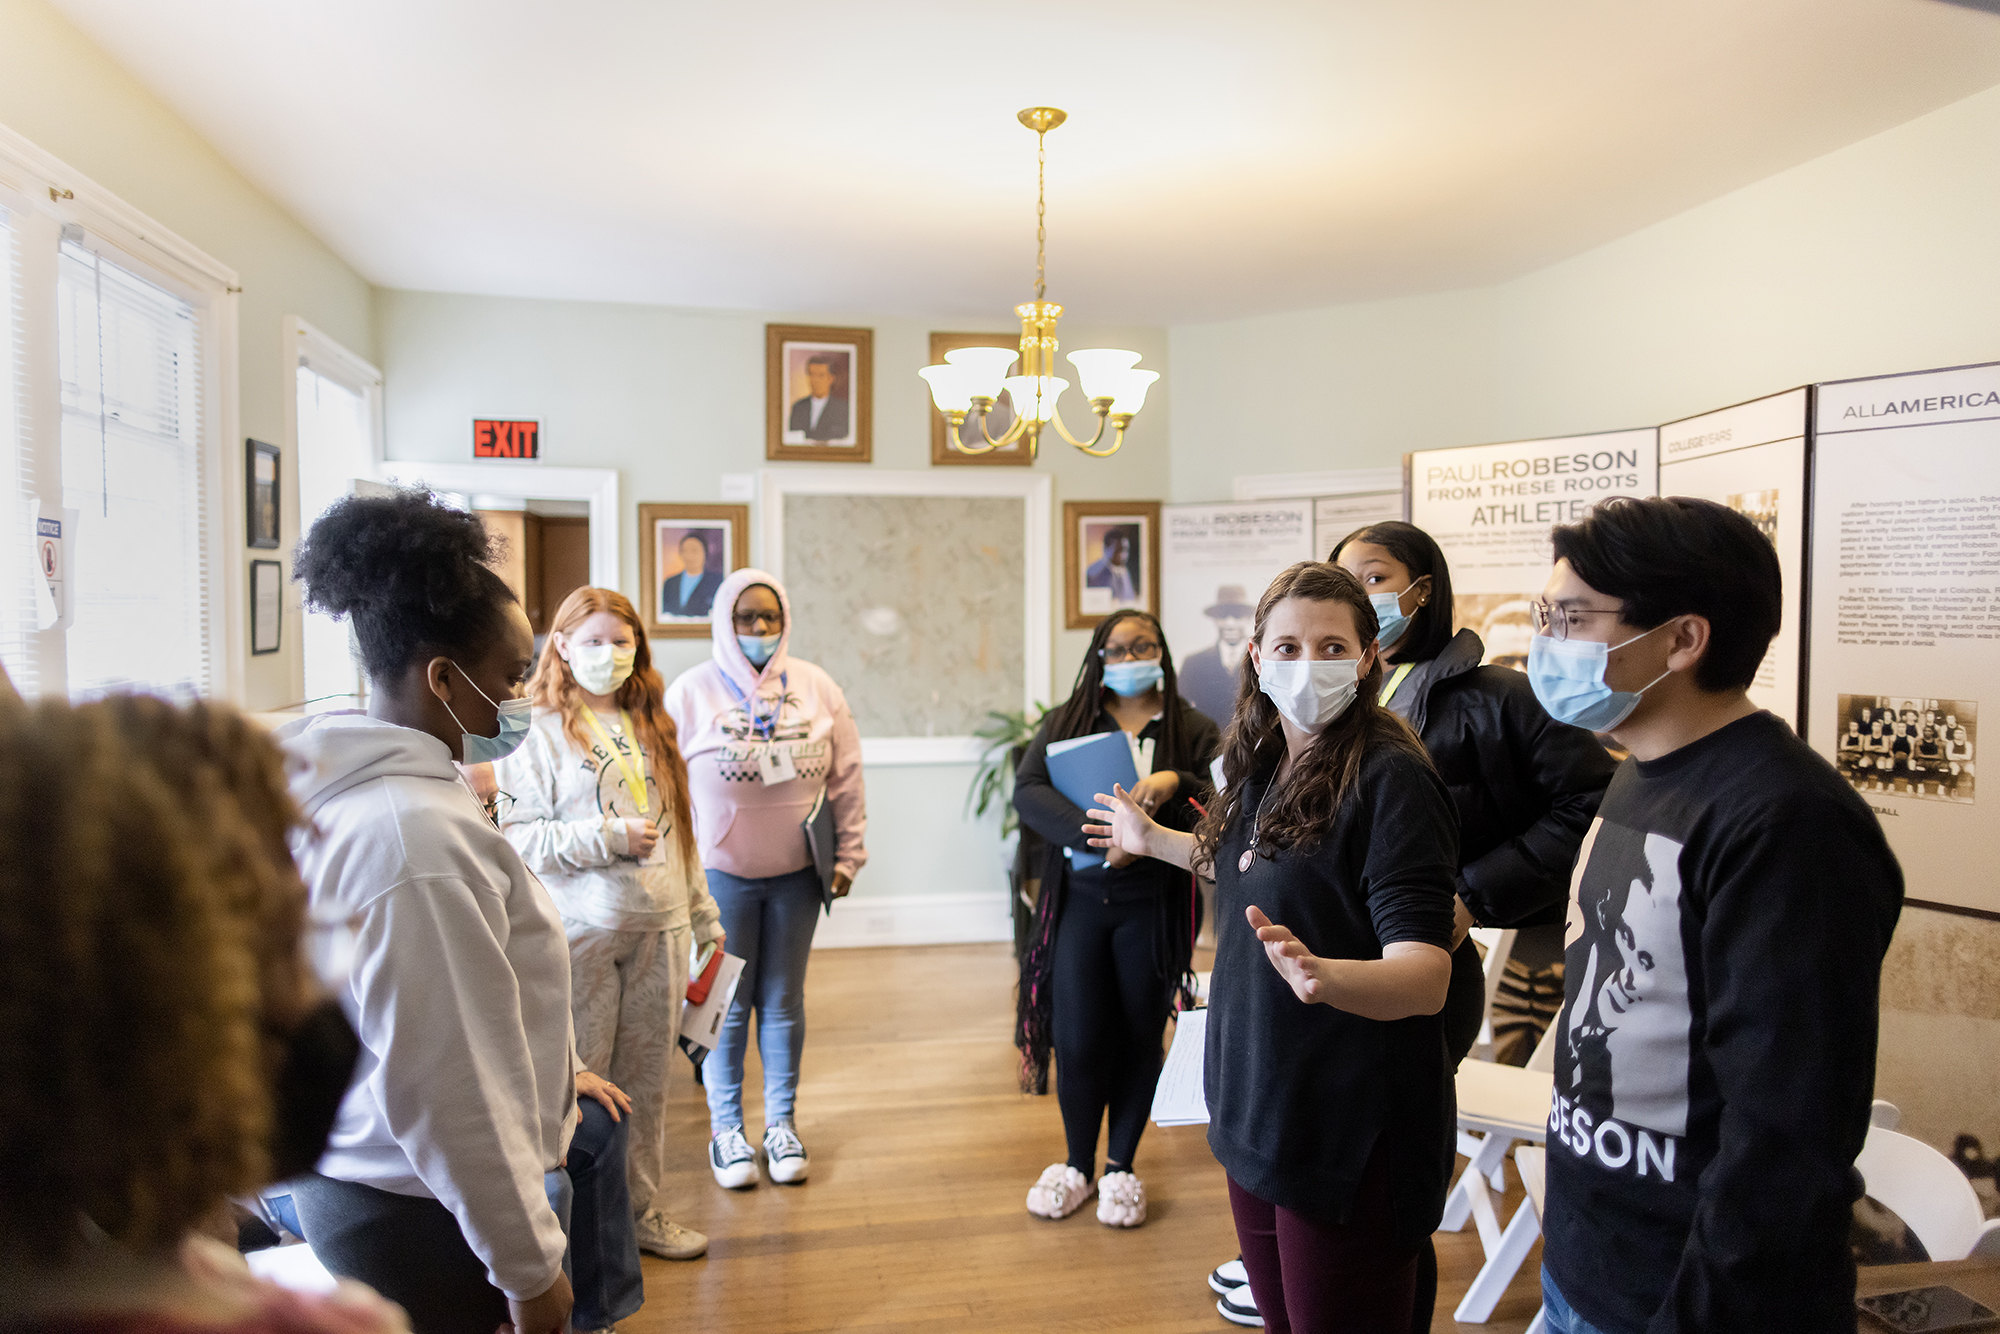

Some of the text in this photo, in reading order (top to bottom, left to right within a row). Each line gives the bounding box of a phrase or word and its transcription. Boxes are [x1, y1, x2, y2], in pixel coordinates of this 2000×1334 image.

[474, 420, 538, 458] EXIT
[1428, 474, 1638, 501] FROM THESE ROOTS
[1550, 1086, 1676, 1182] BESON
